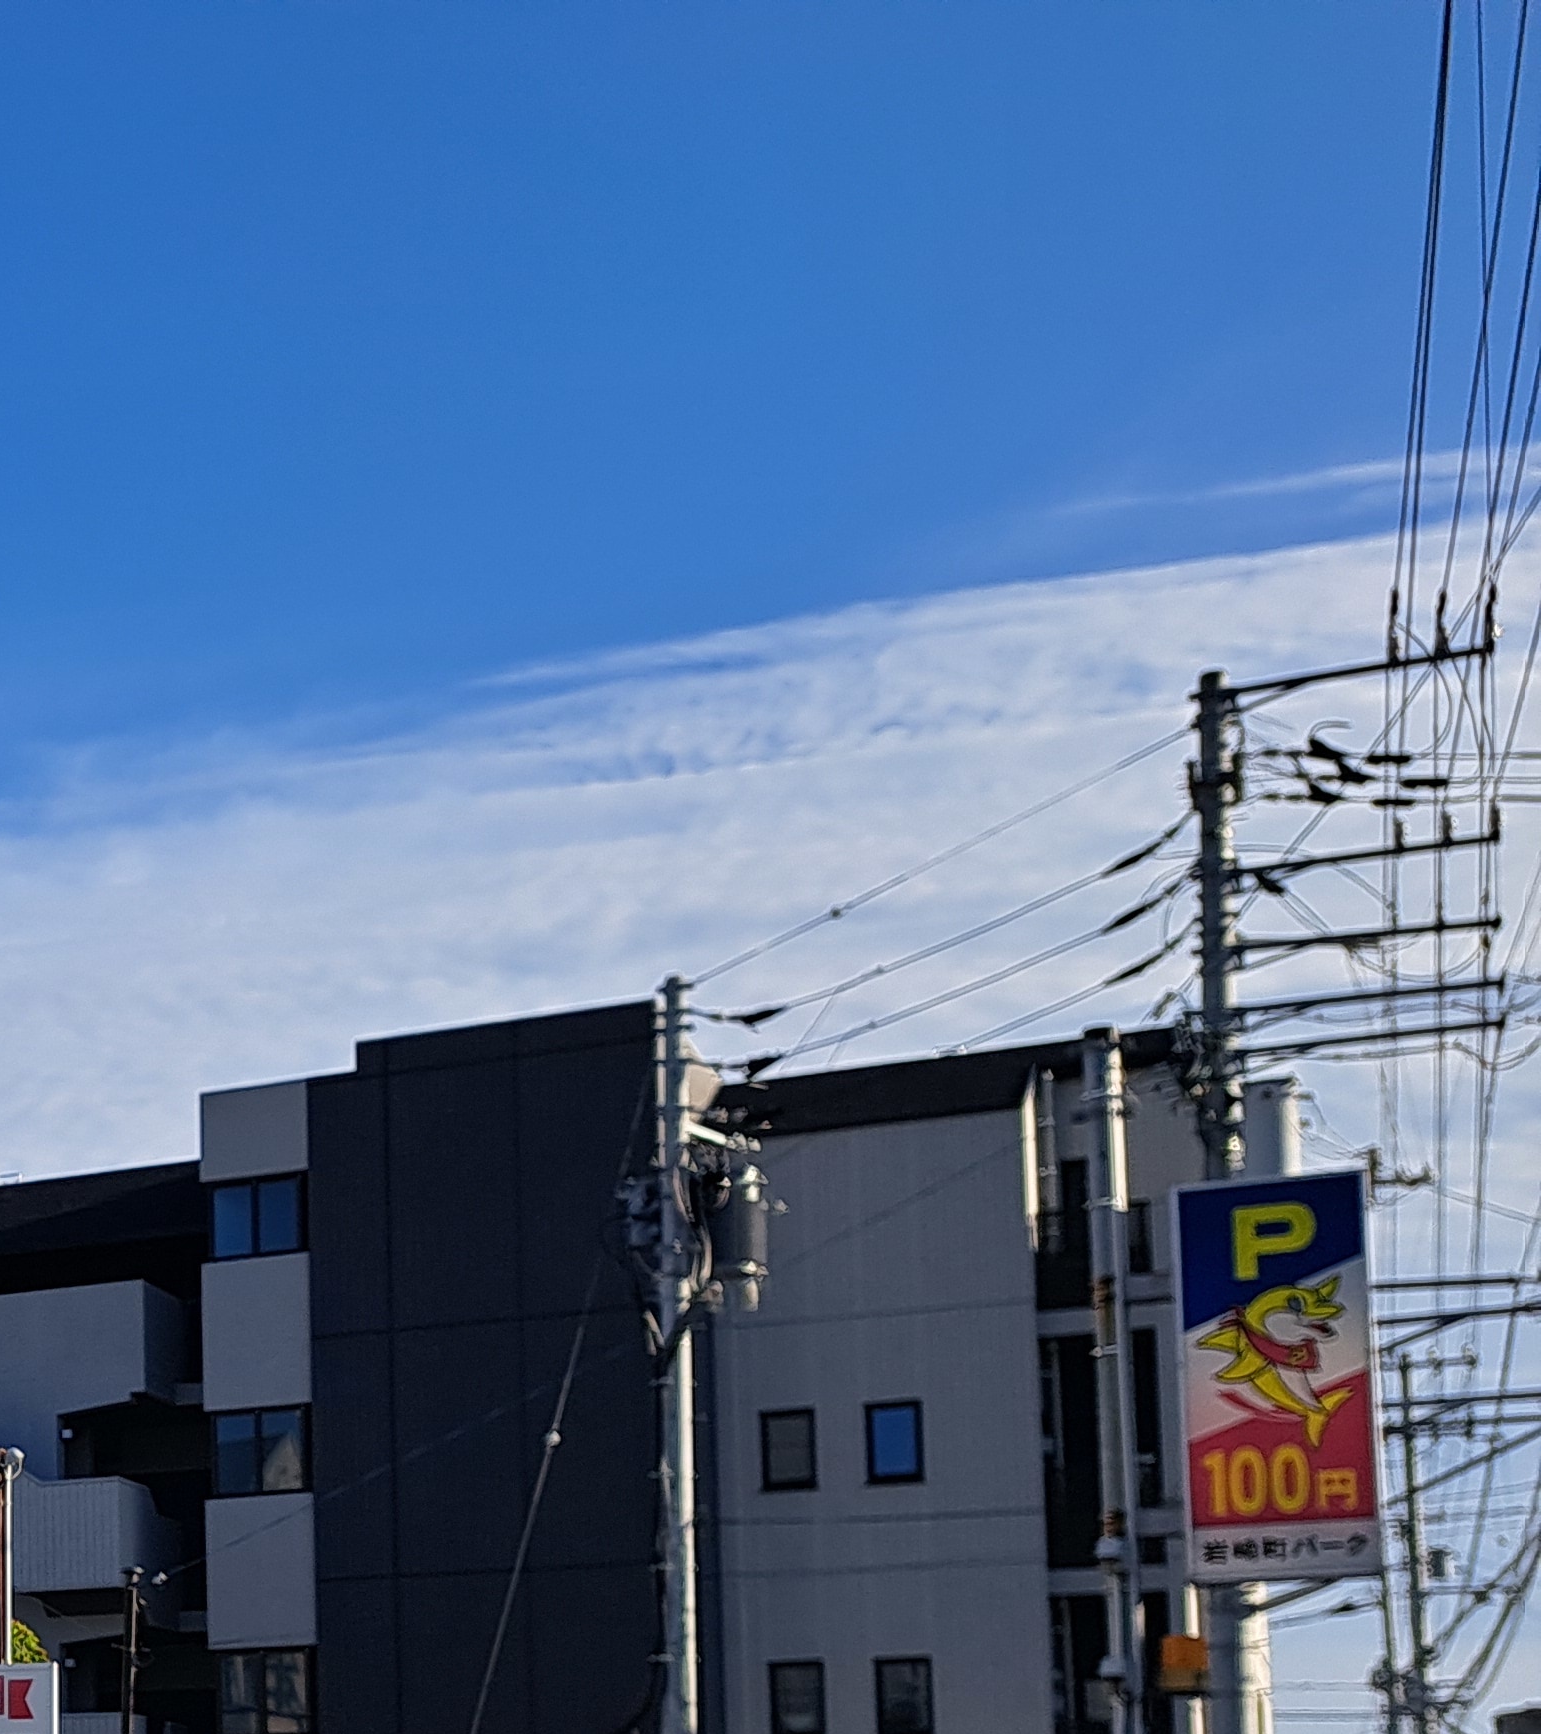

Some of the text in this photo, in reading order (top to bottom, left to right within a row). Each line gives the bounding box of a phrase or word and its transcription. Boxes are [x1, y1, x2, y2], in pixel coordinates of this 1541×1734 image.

[1230, 1203, 1316, 1281] P
[1201, 1442, 1359, 1518] 100円
[1201, 1531, 1369, 1566] 岩崎町パーク
